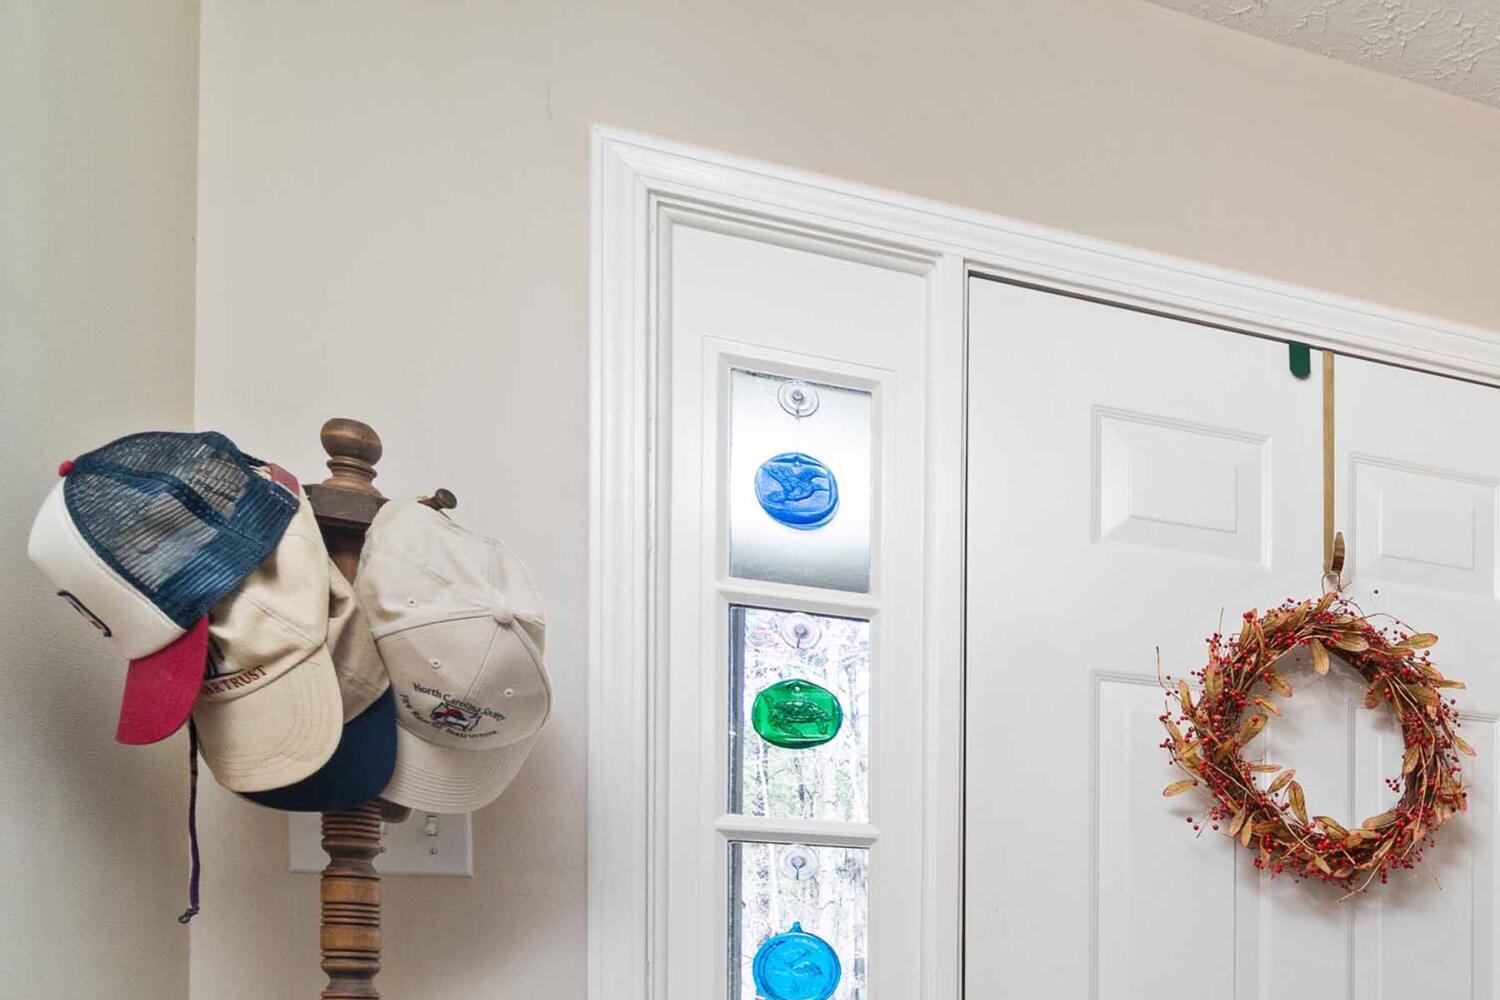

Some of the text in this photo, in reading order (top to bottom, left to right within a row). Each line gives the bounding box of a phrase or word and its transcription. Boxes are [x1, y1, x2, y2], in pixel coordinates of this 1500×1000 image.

[202, 664, 267, 695] ARTRUST
[412, 682, 442, 698] North
[442, 694, 481, 713] Carolina
